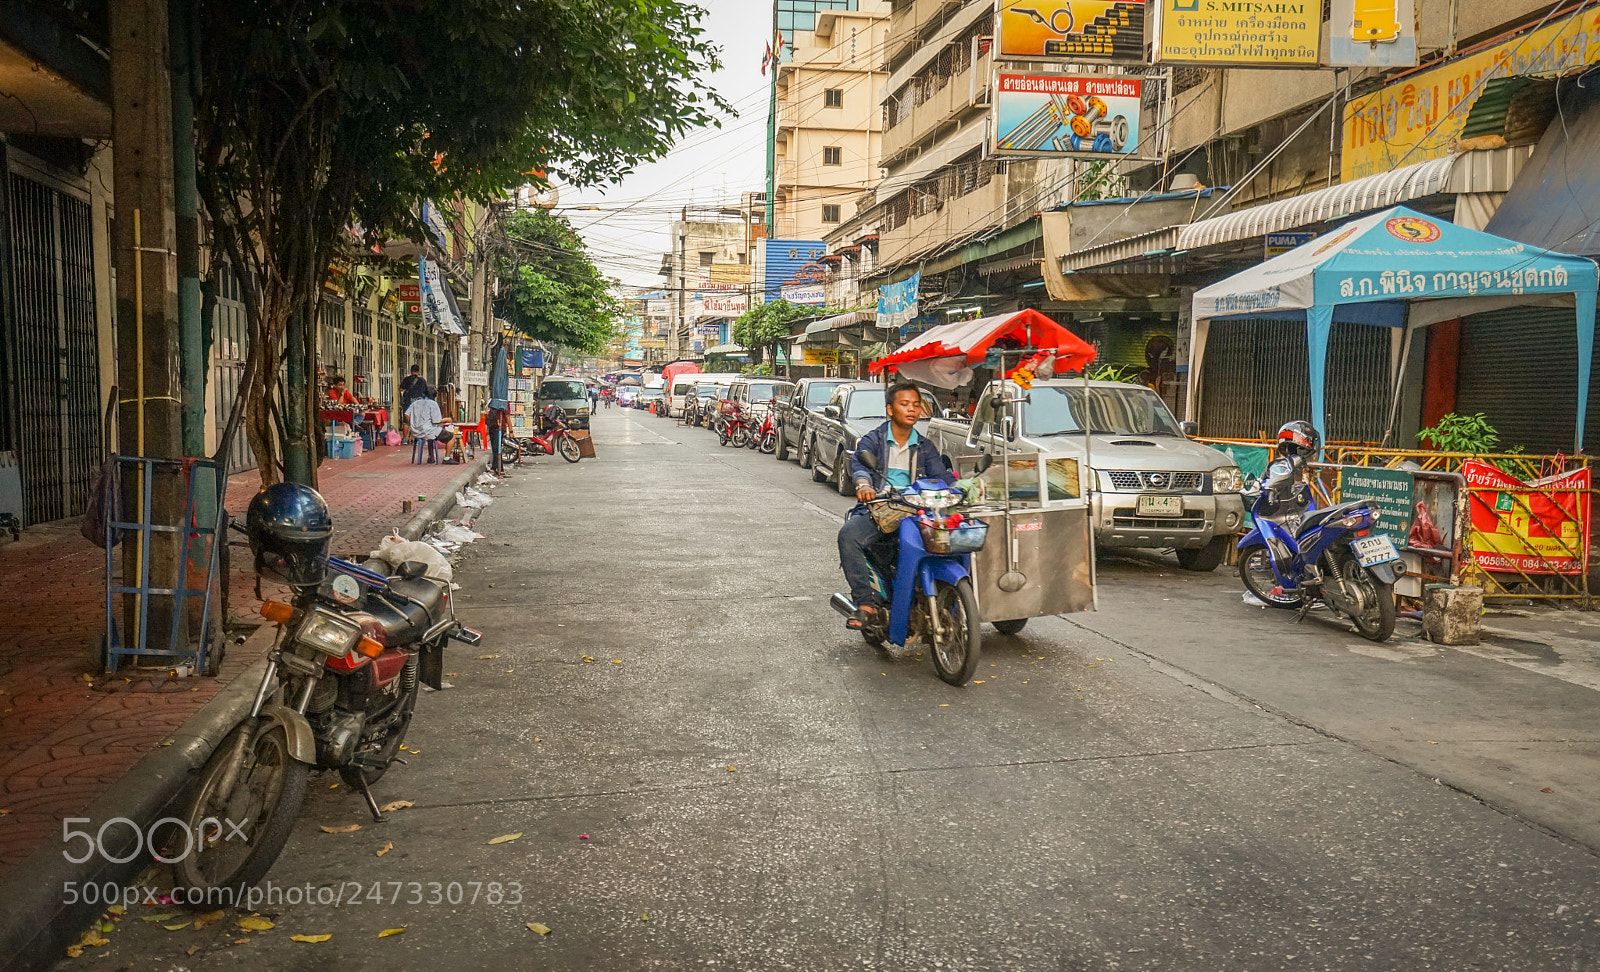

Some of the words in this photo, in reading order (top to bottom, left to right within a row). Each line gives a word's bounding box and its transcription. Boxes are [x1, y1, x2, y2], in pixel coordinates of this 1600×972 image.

[1178, 15, 1227, 28] จำหน่าย
[1236, 13, 1306, 30] เครื่องมือกล
[1194, 29, 1288, 43] อุปกรณ์ก่อสร้าง
[1268, 236, 1297, 246] PUMA
